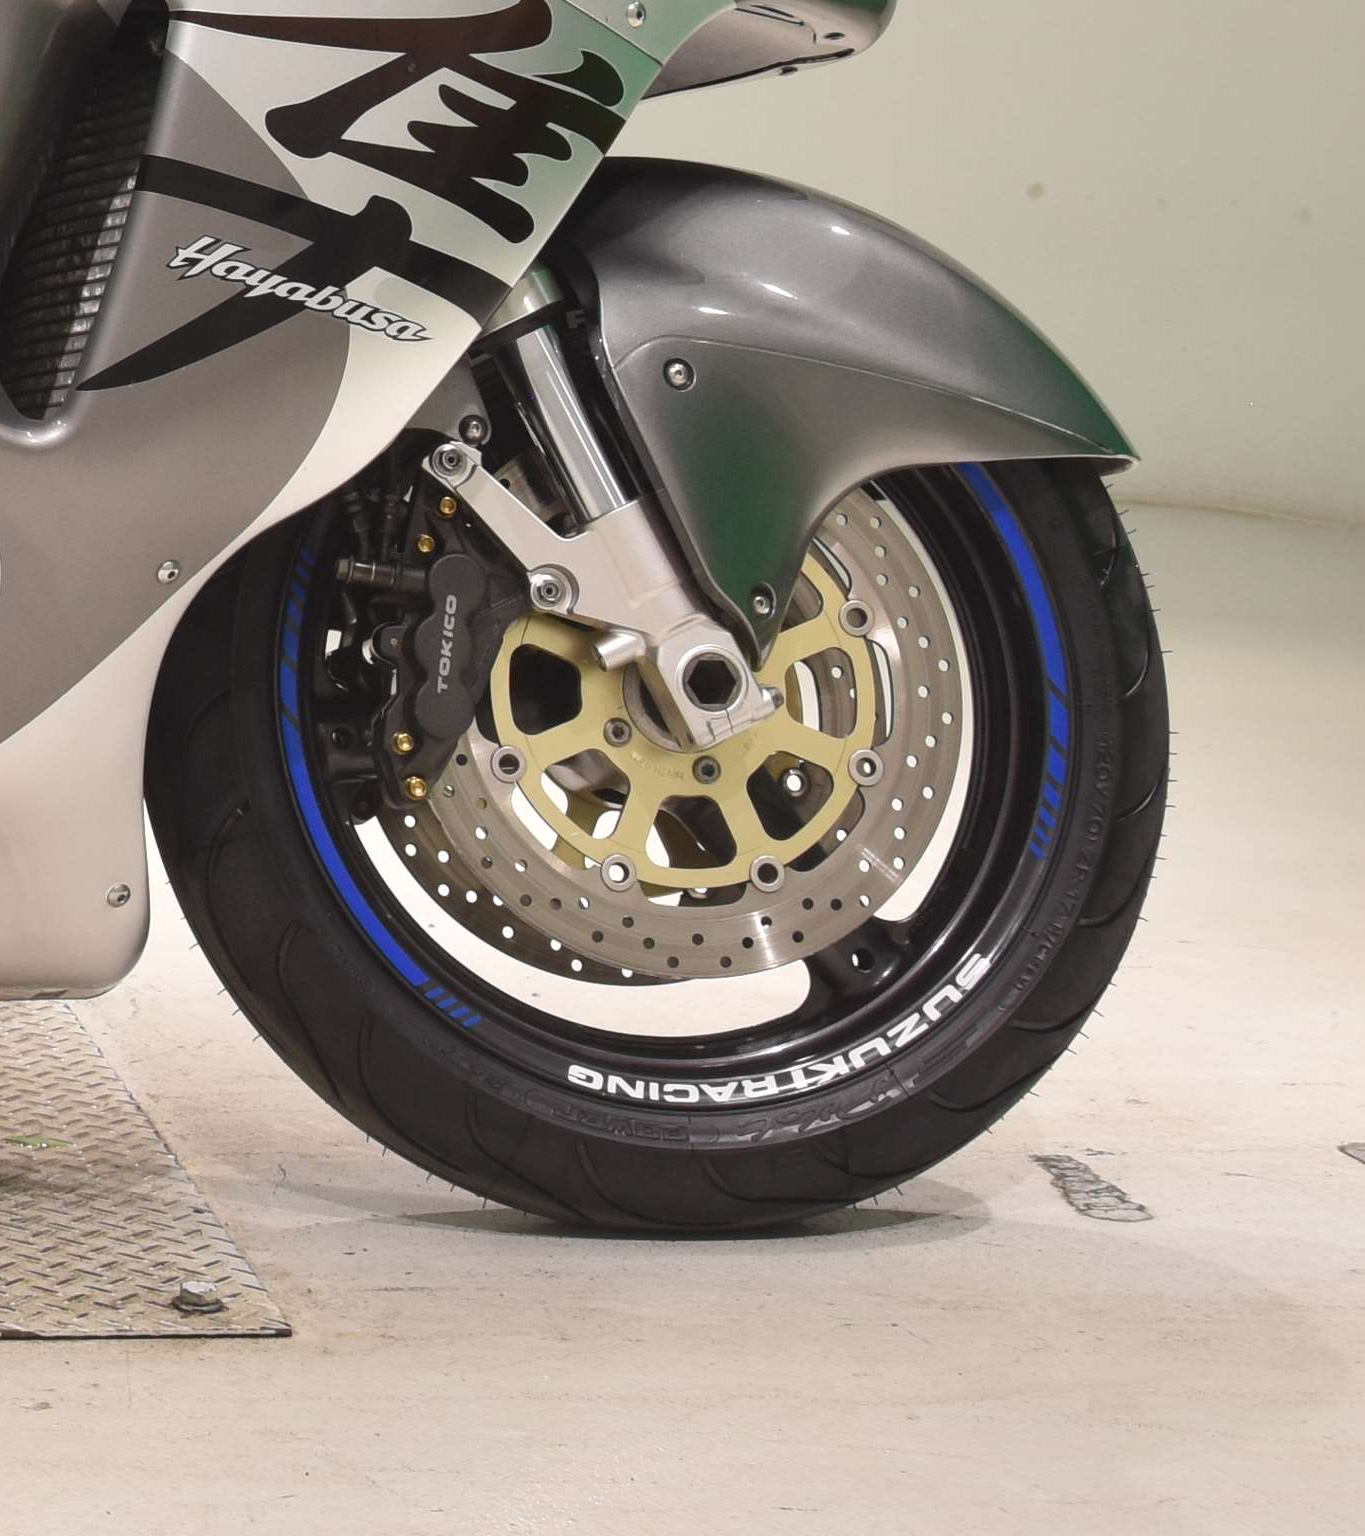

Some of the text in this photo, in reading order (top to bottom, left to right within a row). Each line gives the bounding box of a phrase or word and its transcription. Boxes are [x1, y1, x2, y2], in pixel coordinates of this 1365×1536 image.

[167, 235, 434, 344] Hayabusa
[436, 594, 458, 695] TOKICO
[794, 952, 993, 1090] SUZUKI
[567, 1063, 783, 1104] RACING
